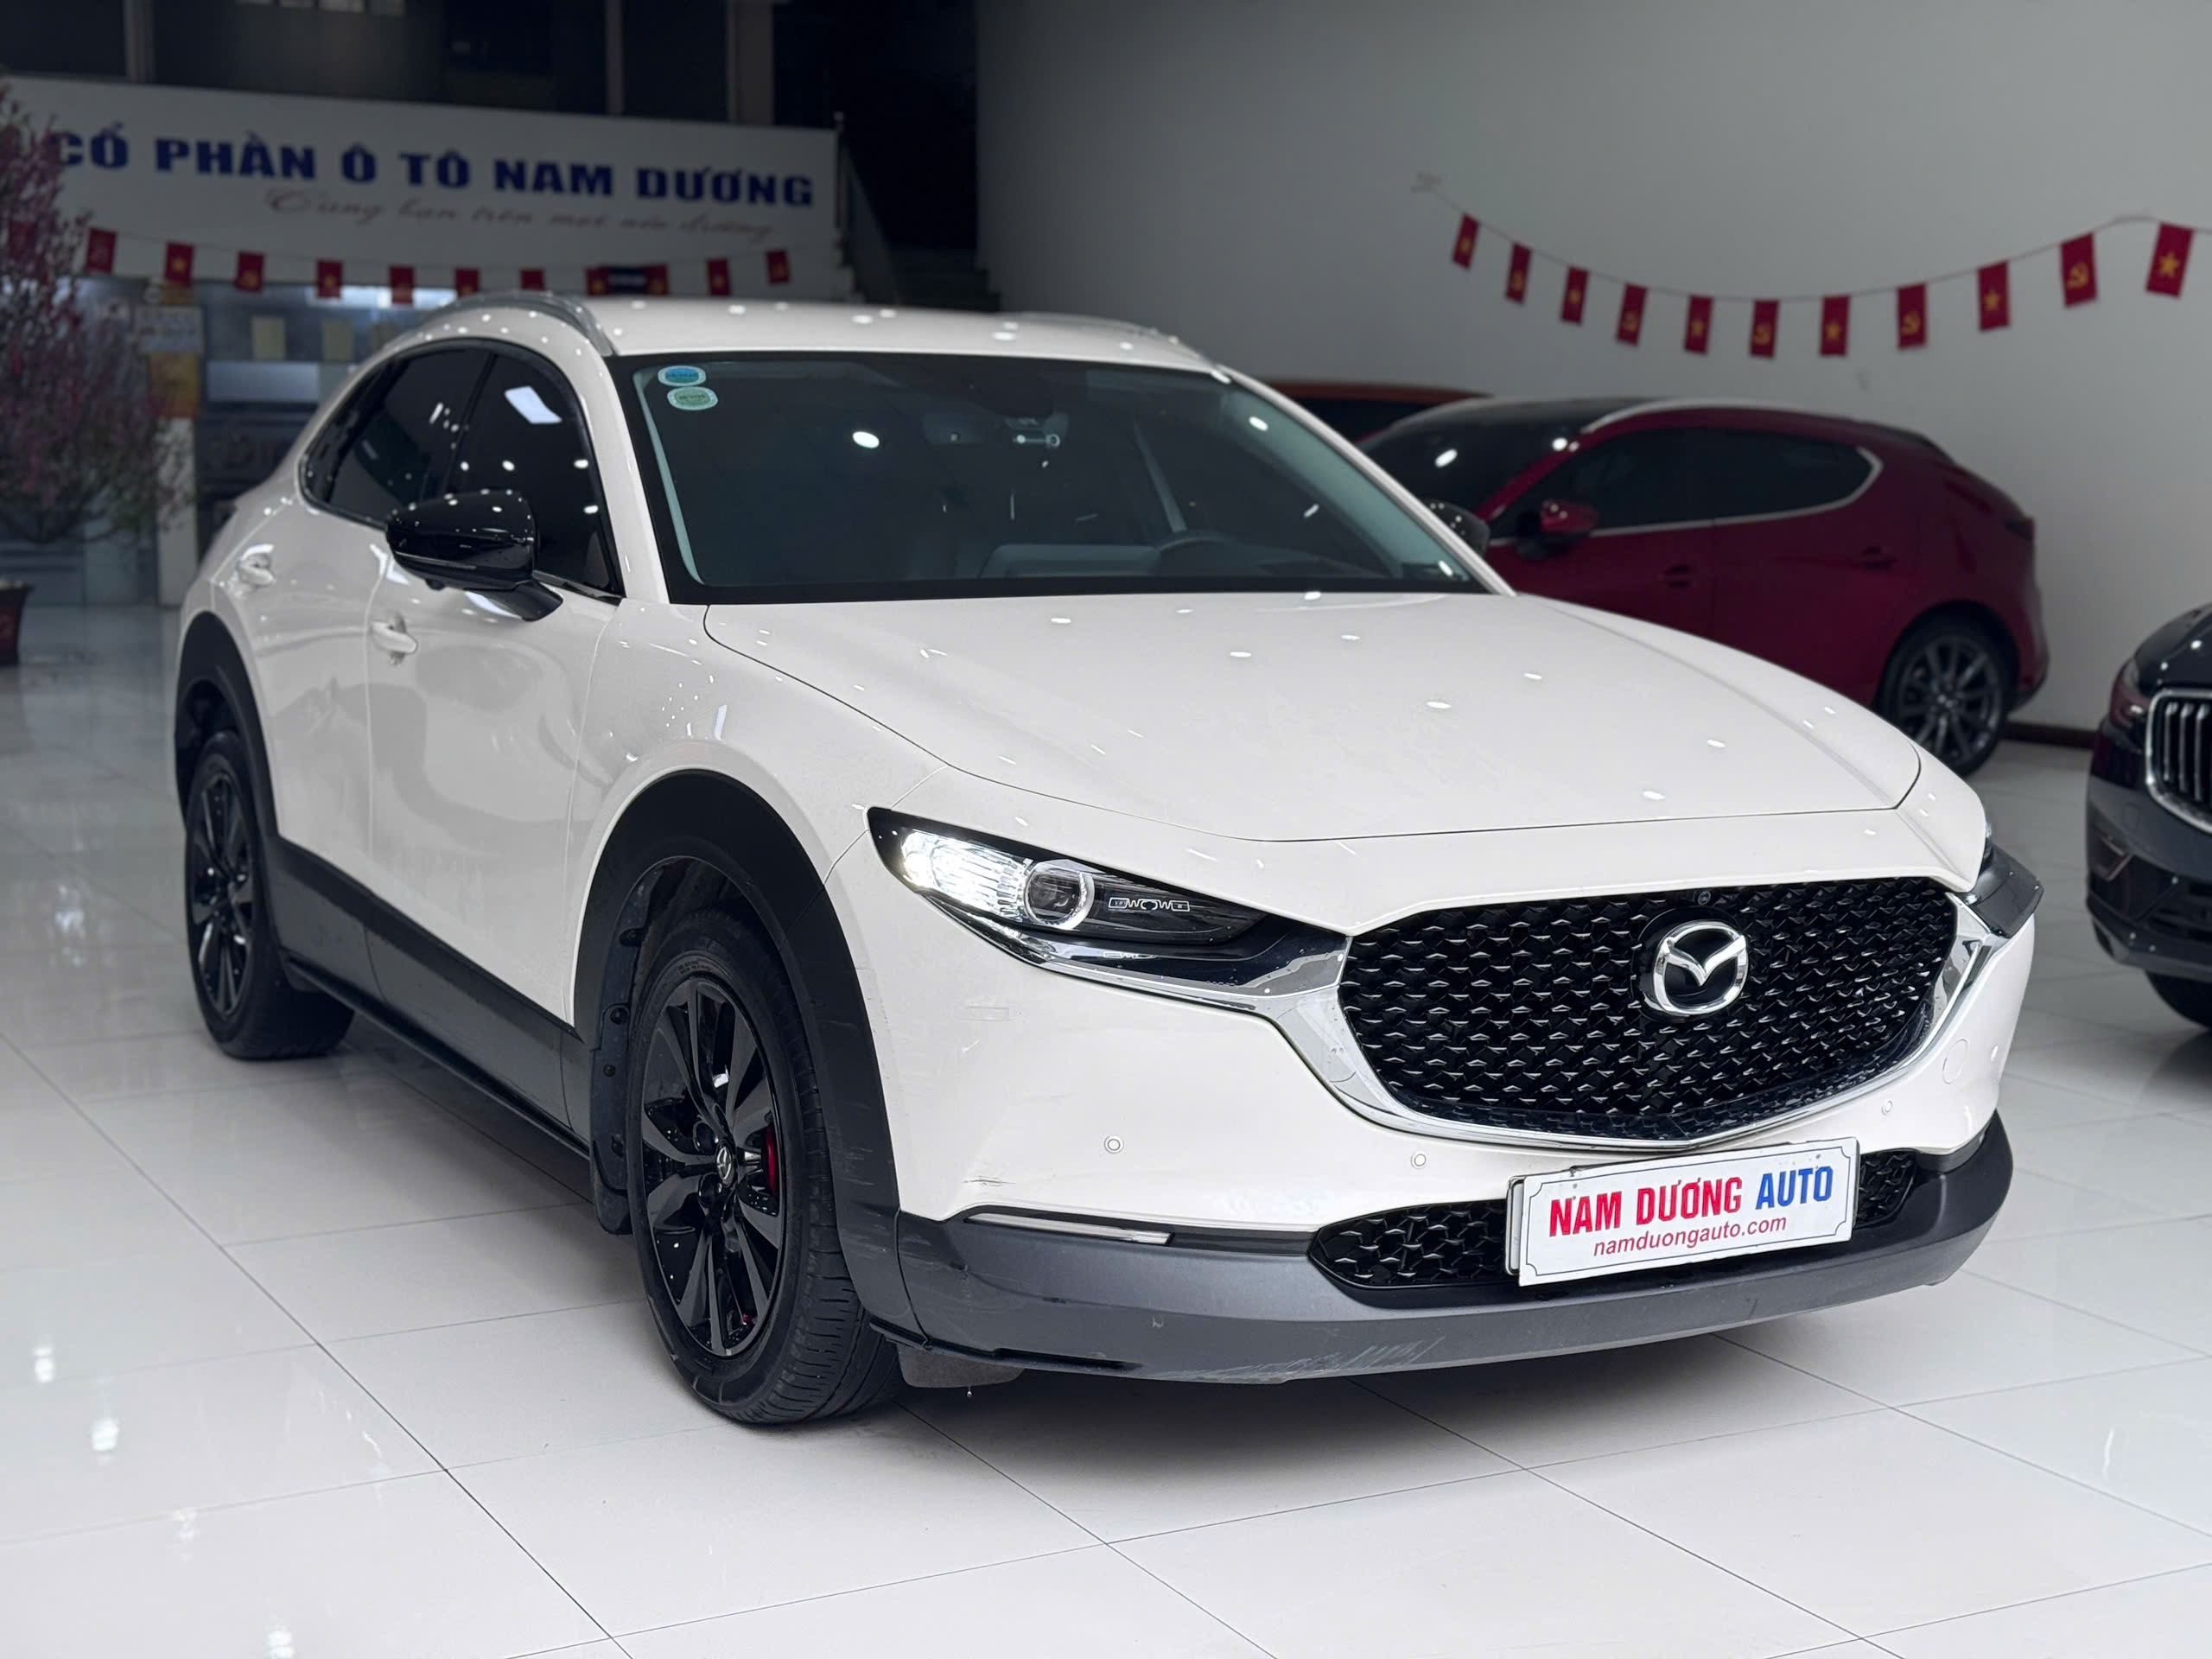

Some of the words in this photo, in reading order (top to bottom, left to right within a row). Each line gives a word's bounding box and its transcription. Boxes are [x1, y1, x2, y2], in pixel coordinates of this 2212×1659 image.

[156, 130, 316, 180] PHẦN
[340, 143, 377, 184] Ô
[399, 150, 471, 189] TÔ
[493, 158, 613, 198] NAM
[636, 165, 815, 207] DƯƠNG
[1549, 1191, 1623, 1237] NAM
[1636, 1177, 1743, 1226] DƯƠNG
[1755, 1166, 1834, 1210] AUTO
[1593, 1217, 1787, 1256] namduongauto.com
